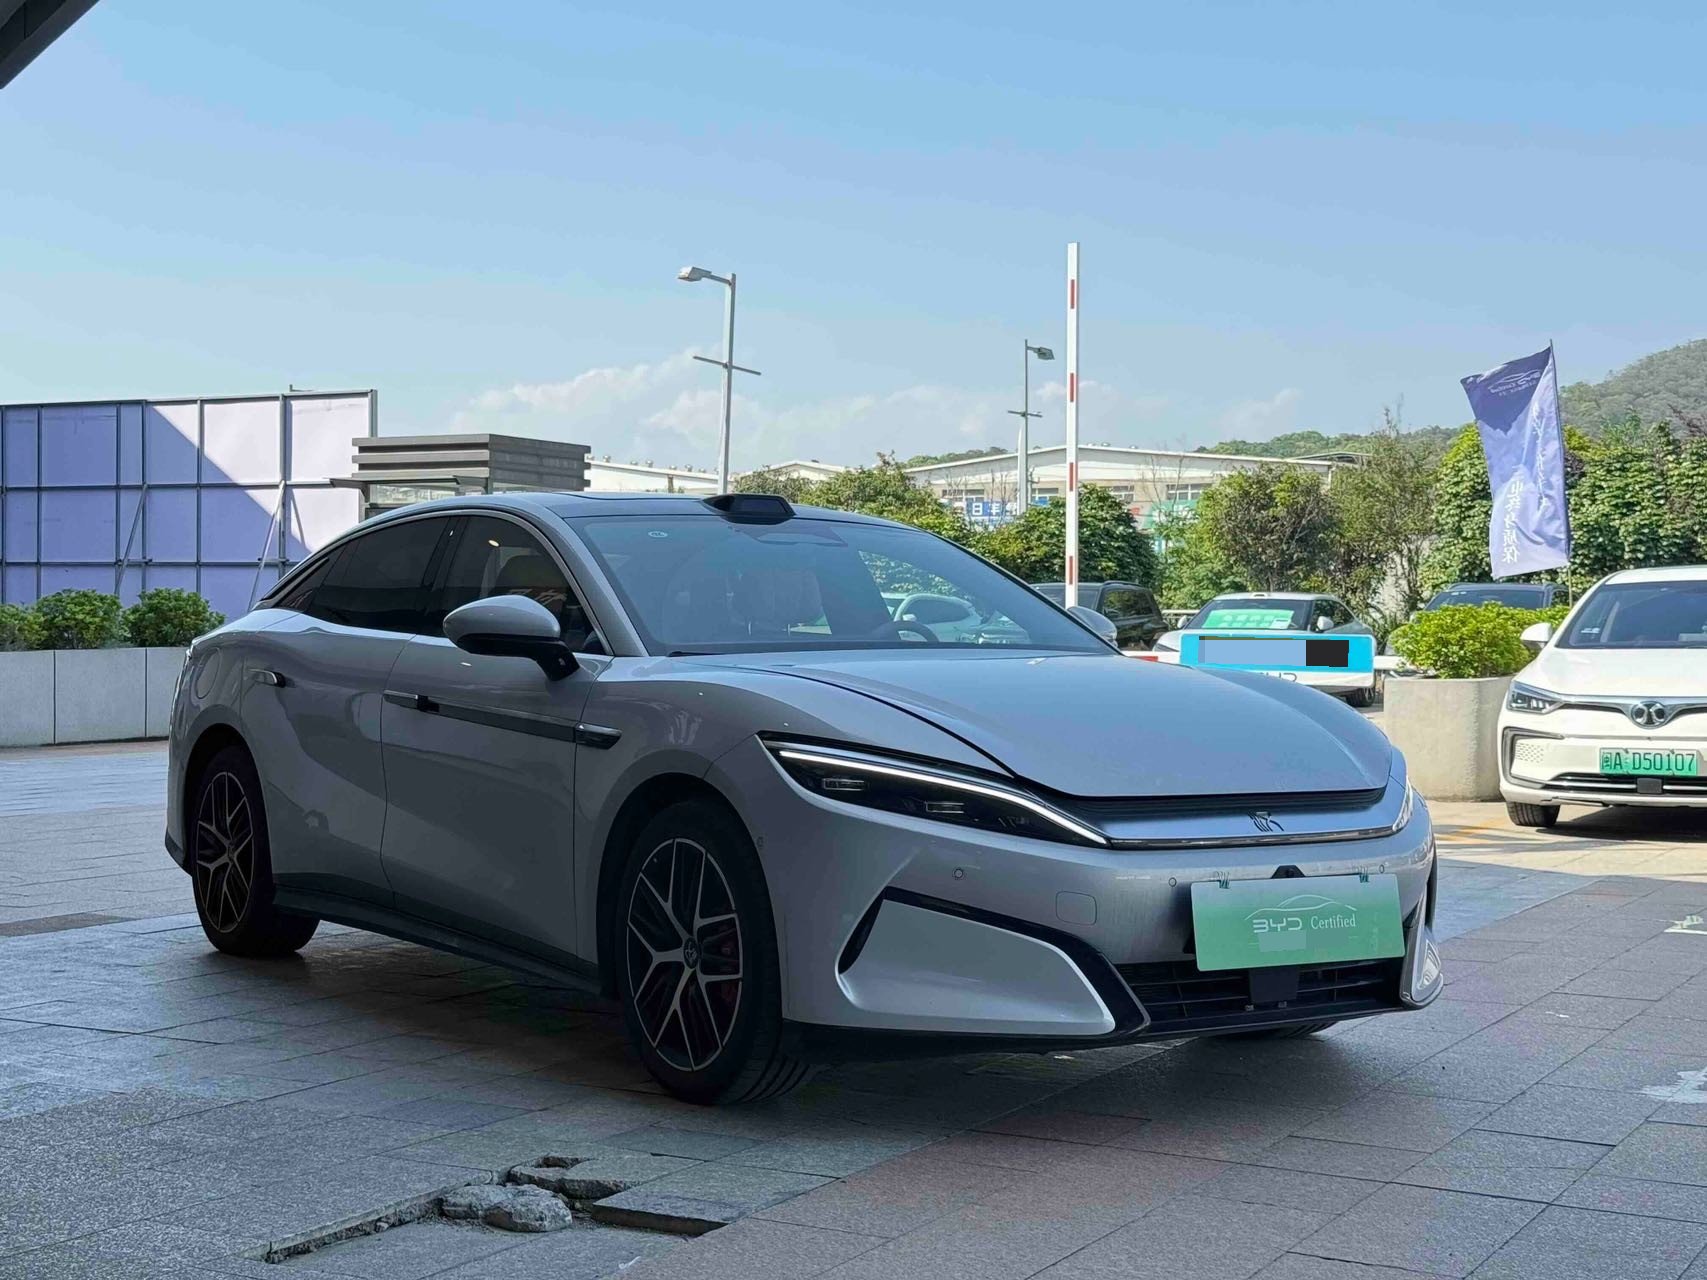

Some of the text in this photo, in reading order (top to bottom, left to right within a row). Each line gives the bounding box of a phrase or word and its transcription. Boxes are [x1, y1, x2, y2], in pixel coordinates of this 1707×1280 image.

[1632, 753, 1695, 771] D50107
[1252, 914, 1357, 933] BYD Certified
